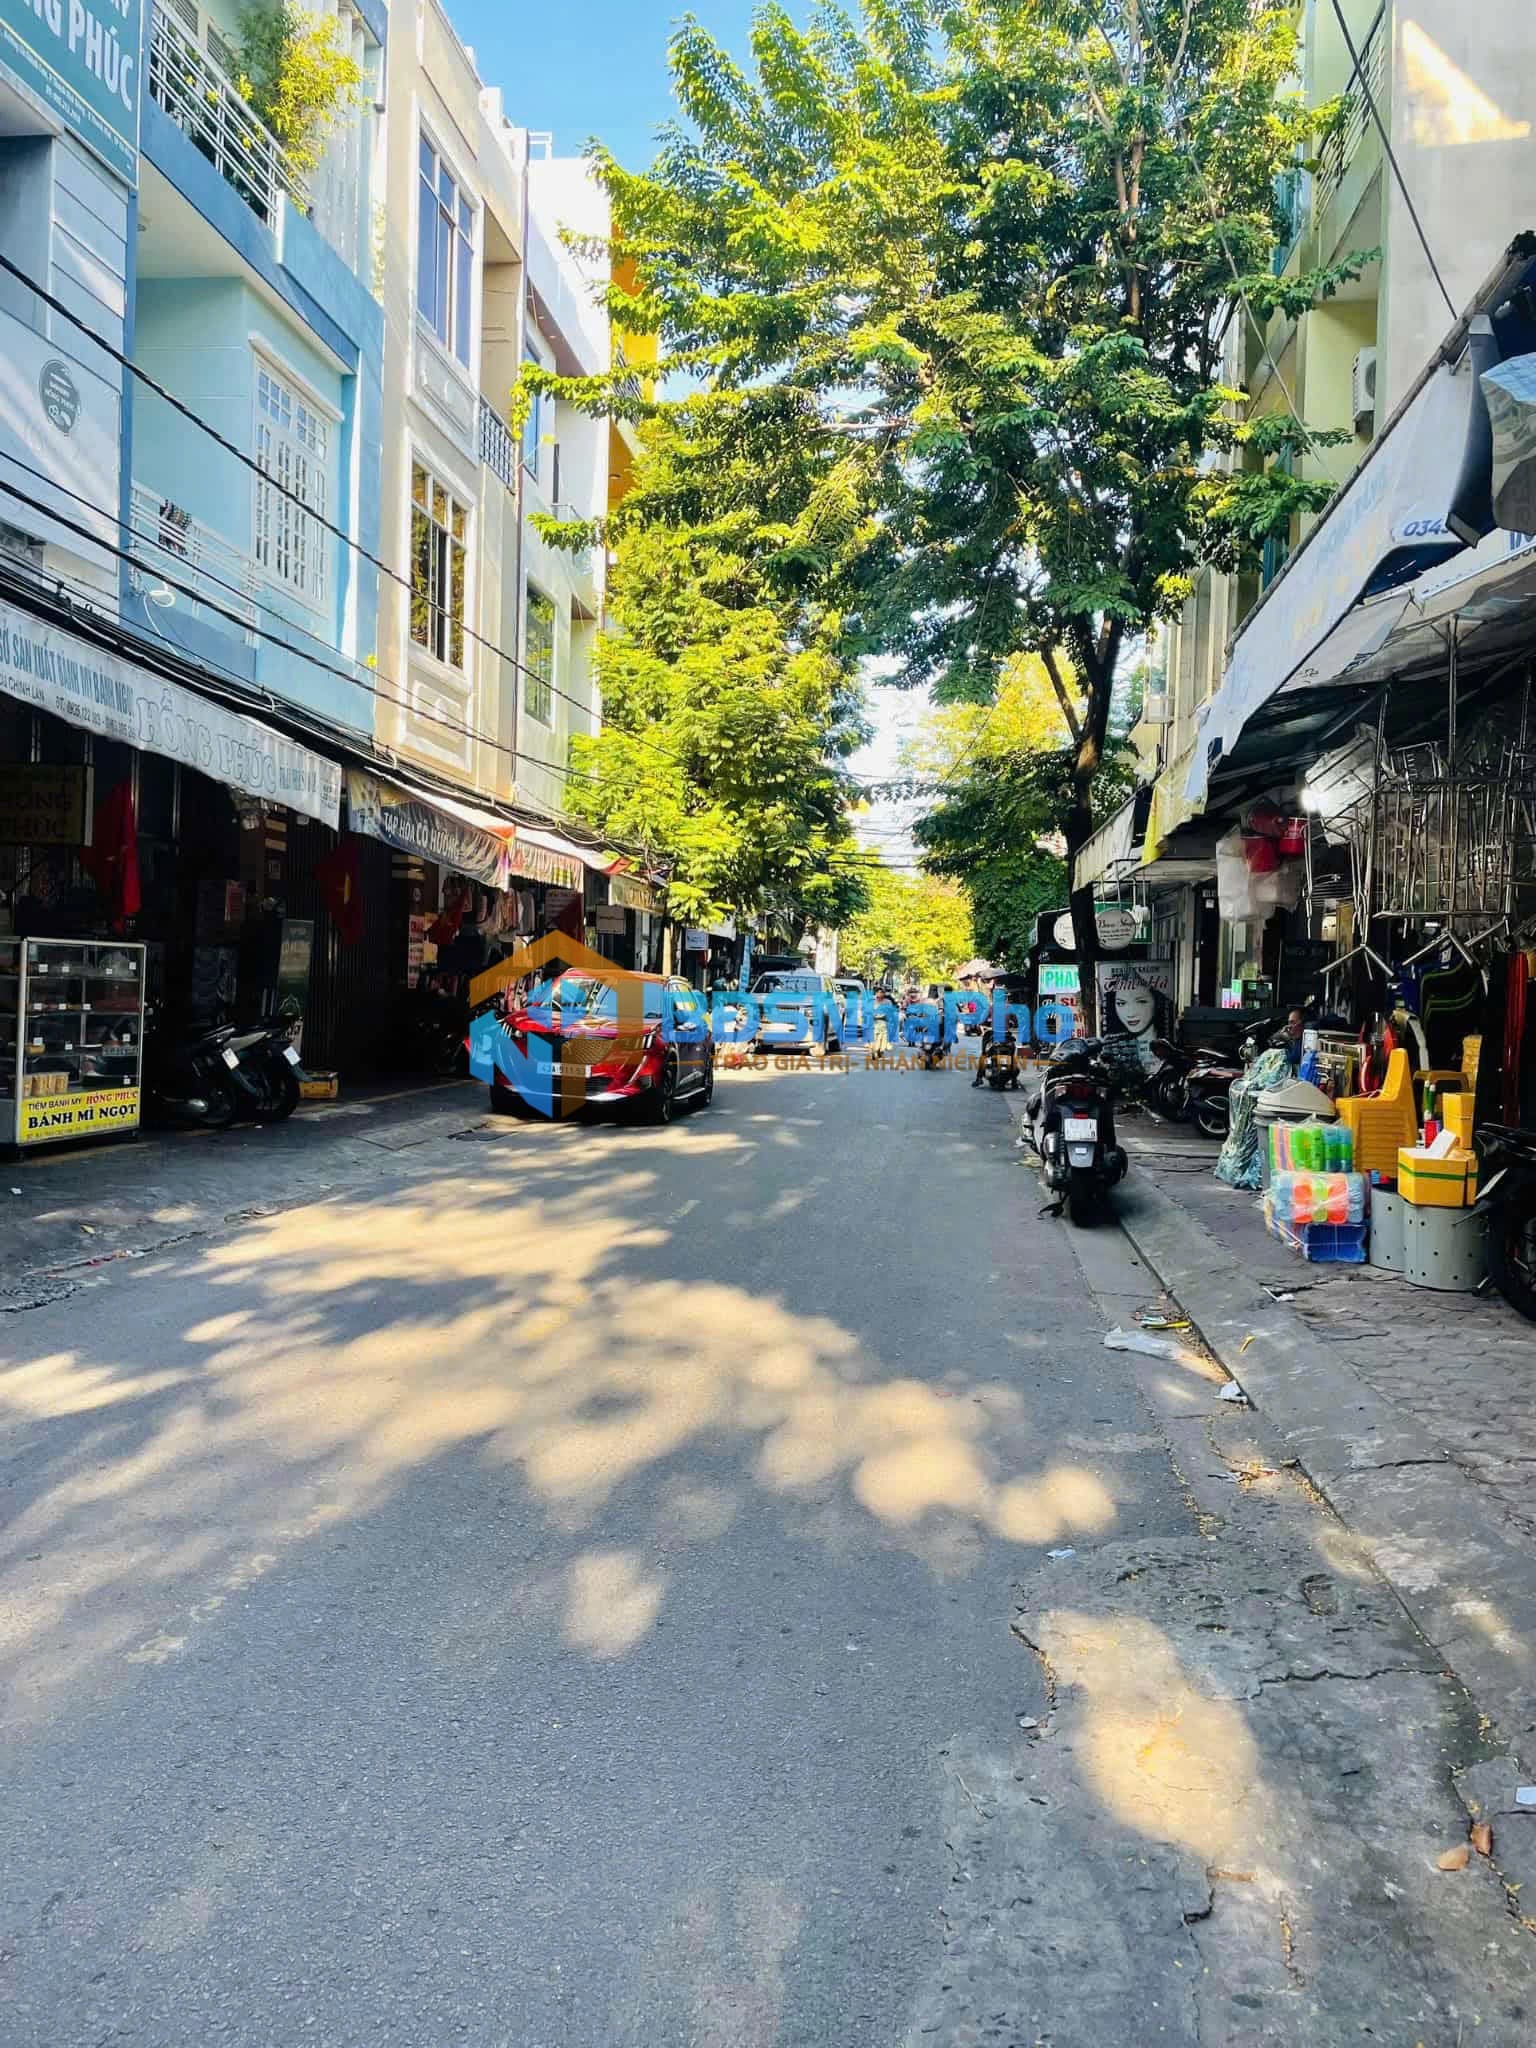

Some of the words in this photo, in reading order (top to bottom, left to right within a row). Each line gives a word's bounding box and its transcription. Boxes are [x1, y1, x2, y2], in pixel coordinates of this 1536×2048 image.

[68, 0, 133, 112] PHÚC
[1404, 519, 1448, 537] 034
[137, 688, 211, 767] HỒNG
[216, 734, 277, 794] PHÚC
[28, 1112, 73, 1129] BÁNH
[77, 1105, 95, 1122] MÌ
[99, 1104, 137, 1119] NGỌT
